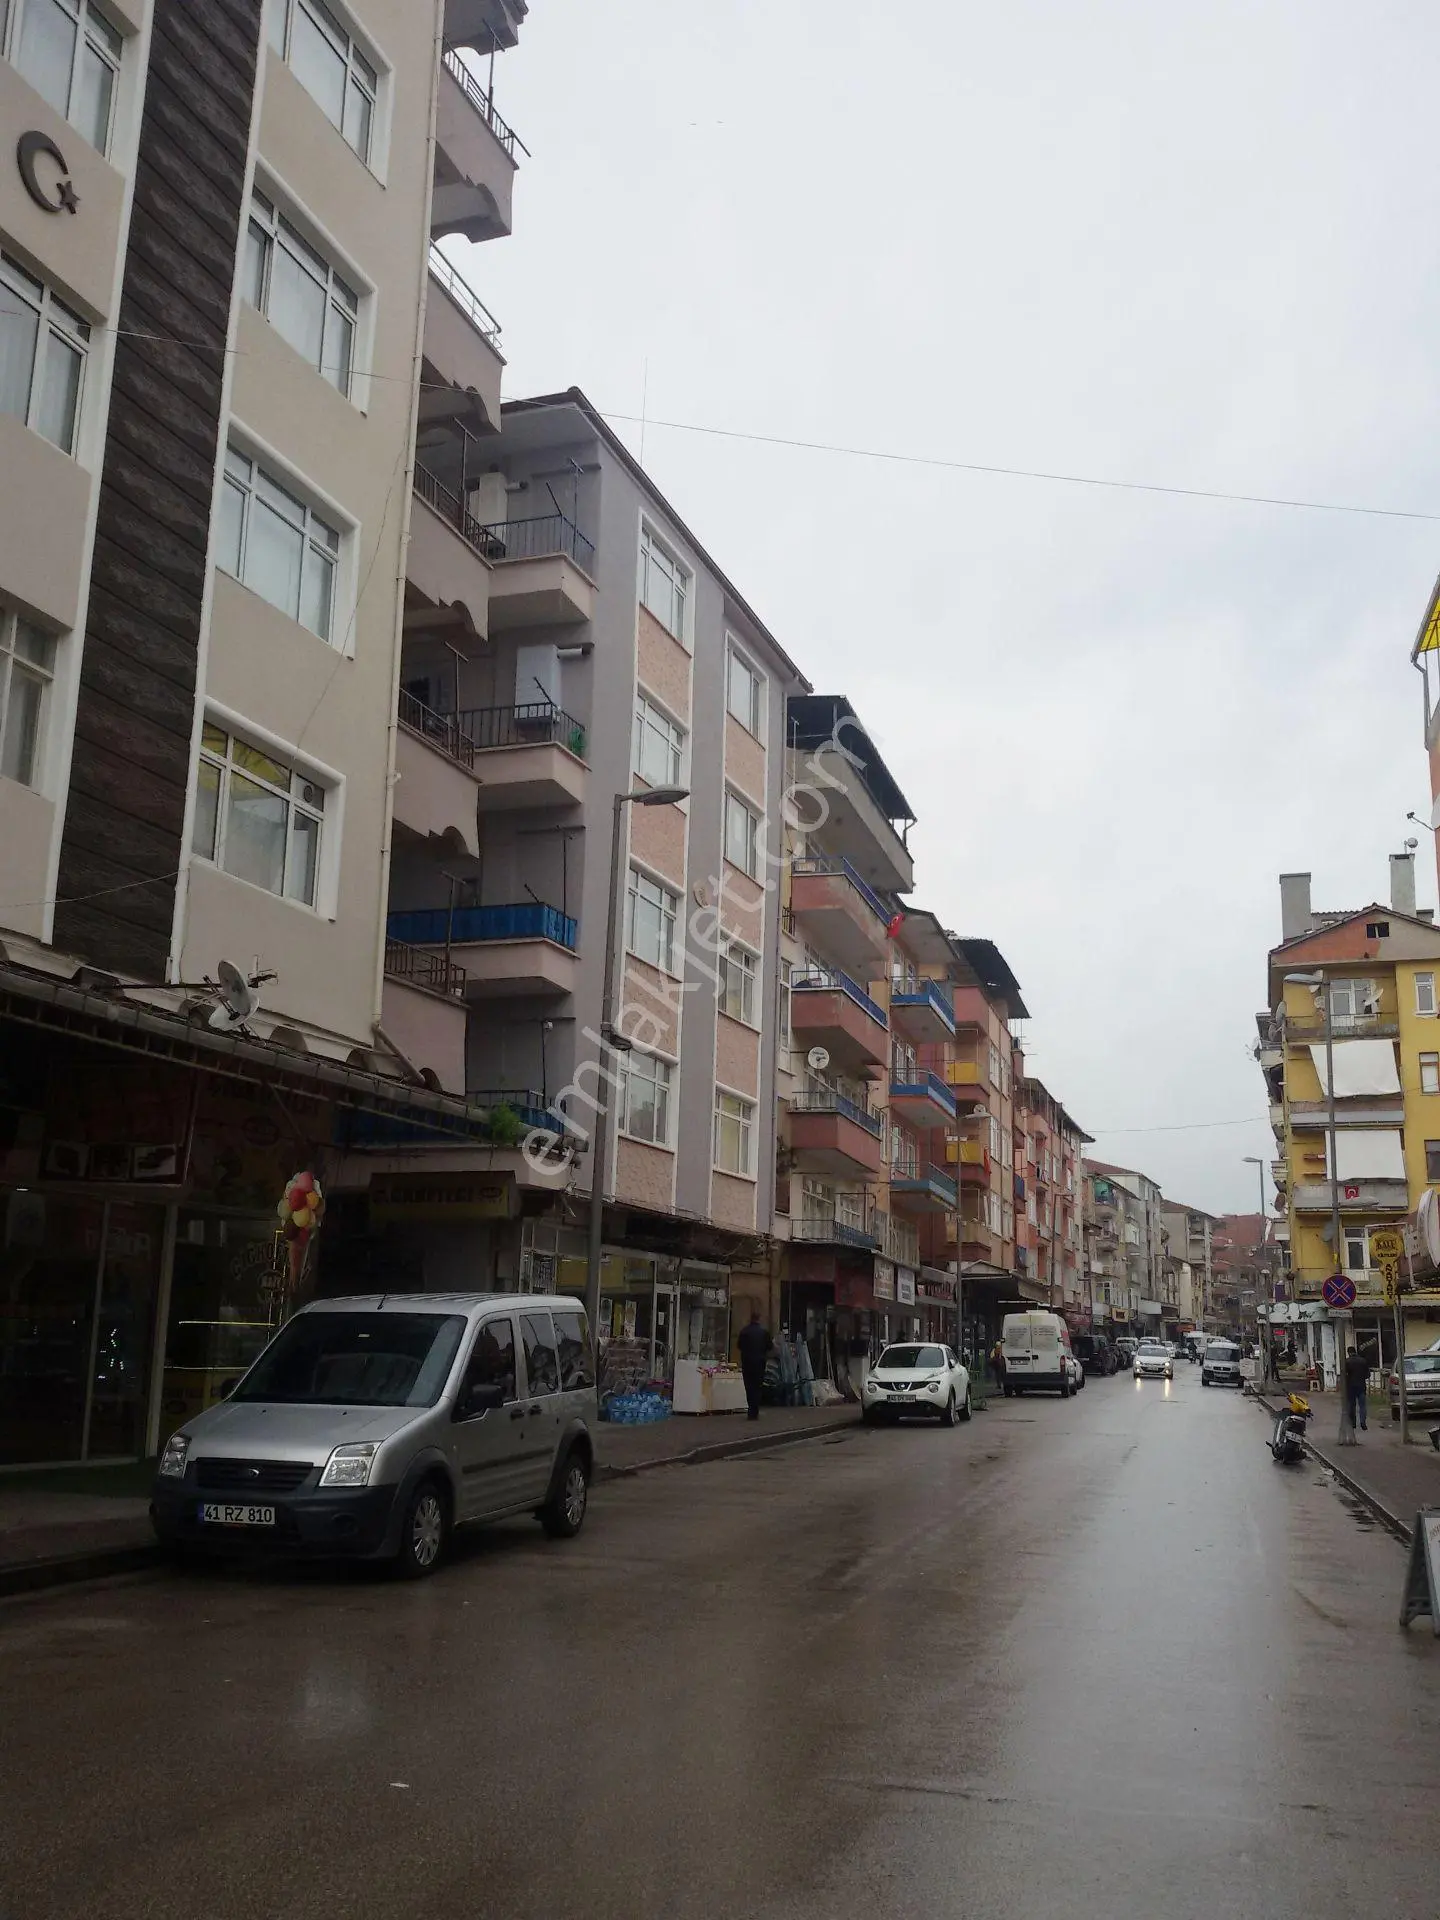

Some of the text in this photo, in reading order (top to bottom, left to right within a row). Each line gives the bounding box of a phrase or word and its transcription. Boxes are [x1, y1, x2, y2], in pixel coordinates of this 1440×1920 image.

[205, 1506, 272, 1522] 41 RZ 810
